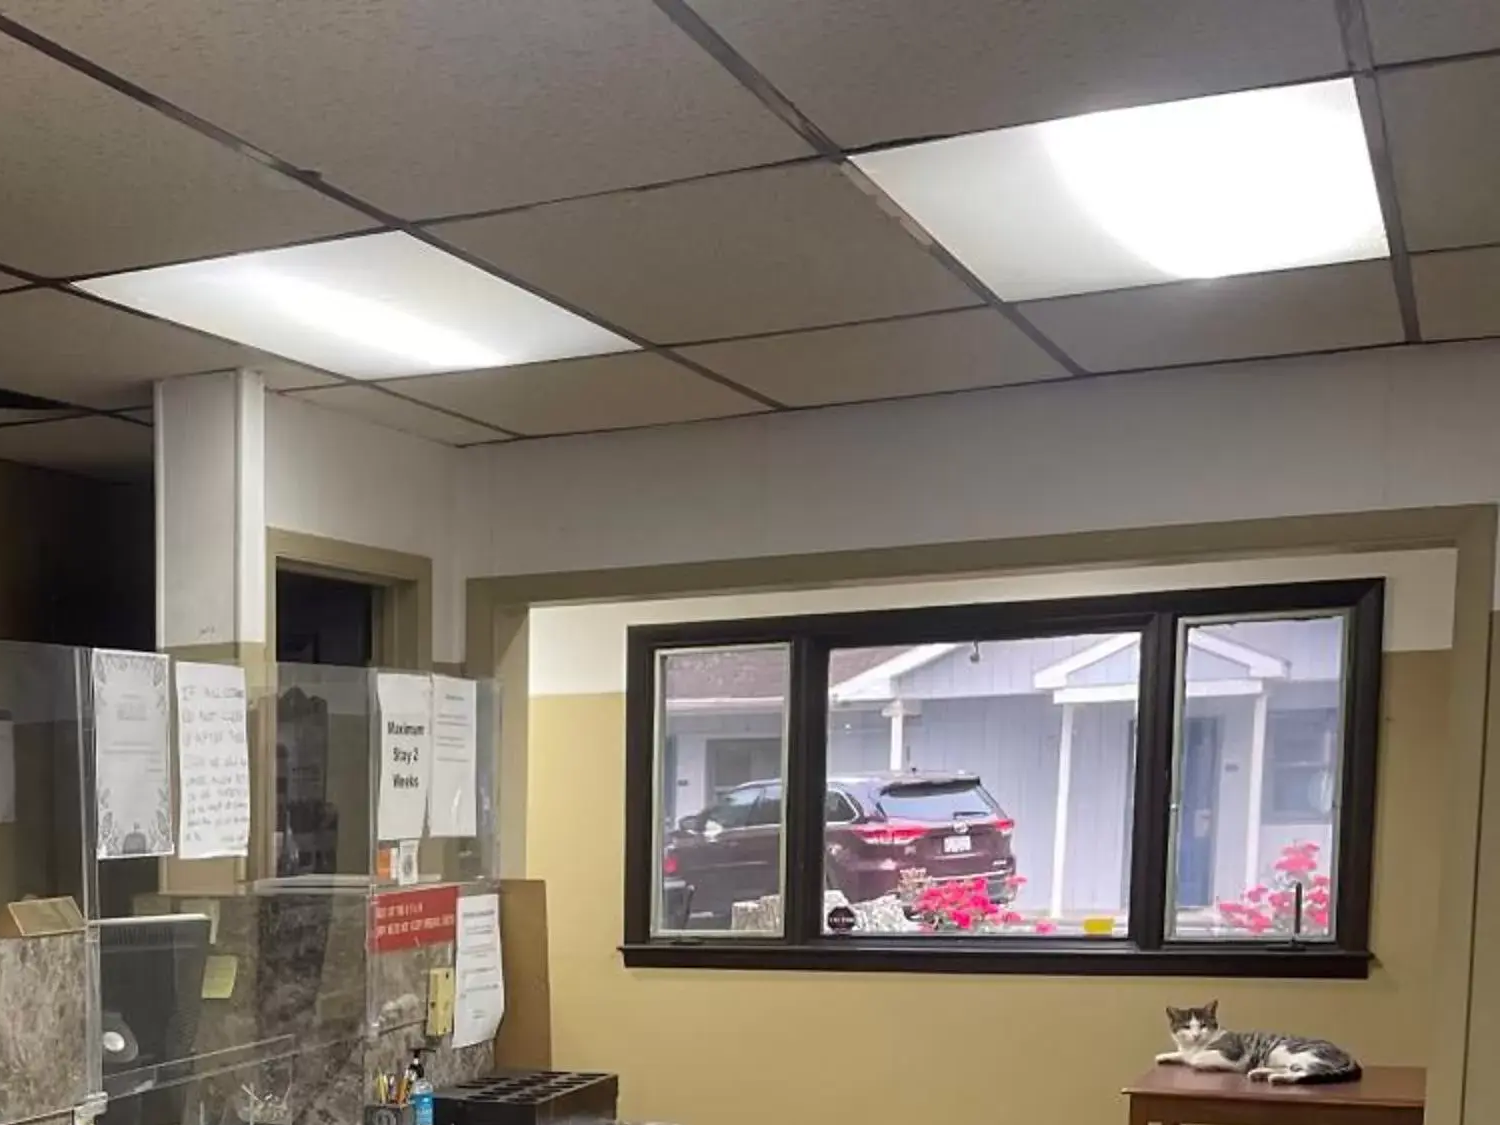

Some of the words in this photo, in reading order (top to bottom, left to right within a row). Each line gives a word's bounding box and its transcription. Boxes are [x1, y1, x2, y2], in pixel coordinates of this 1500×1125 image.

[387, 721, 425, 736] Maximum
[393, 747, 412, 764] Stay
[393, 774, 419, 789] Weeks
